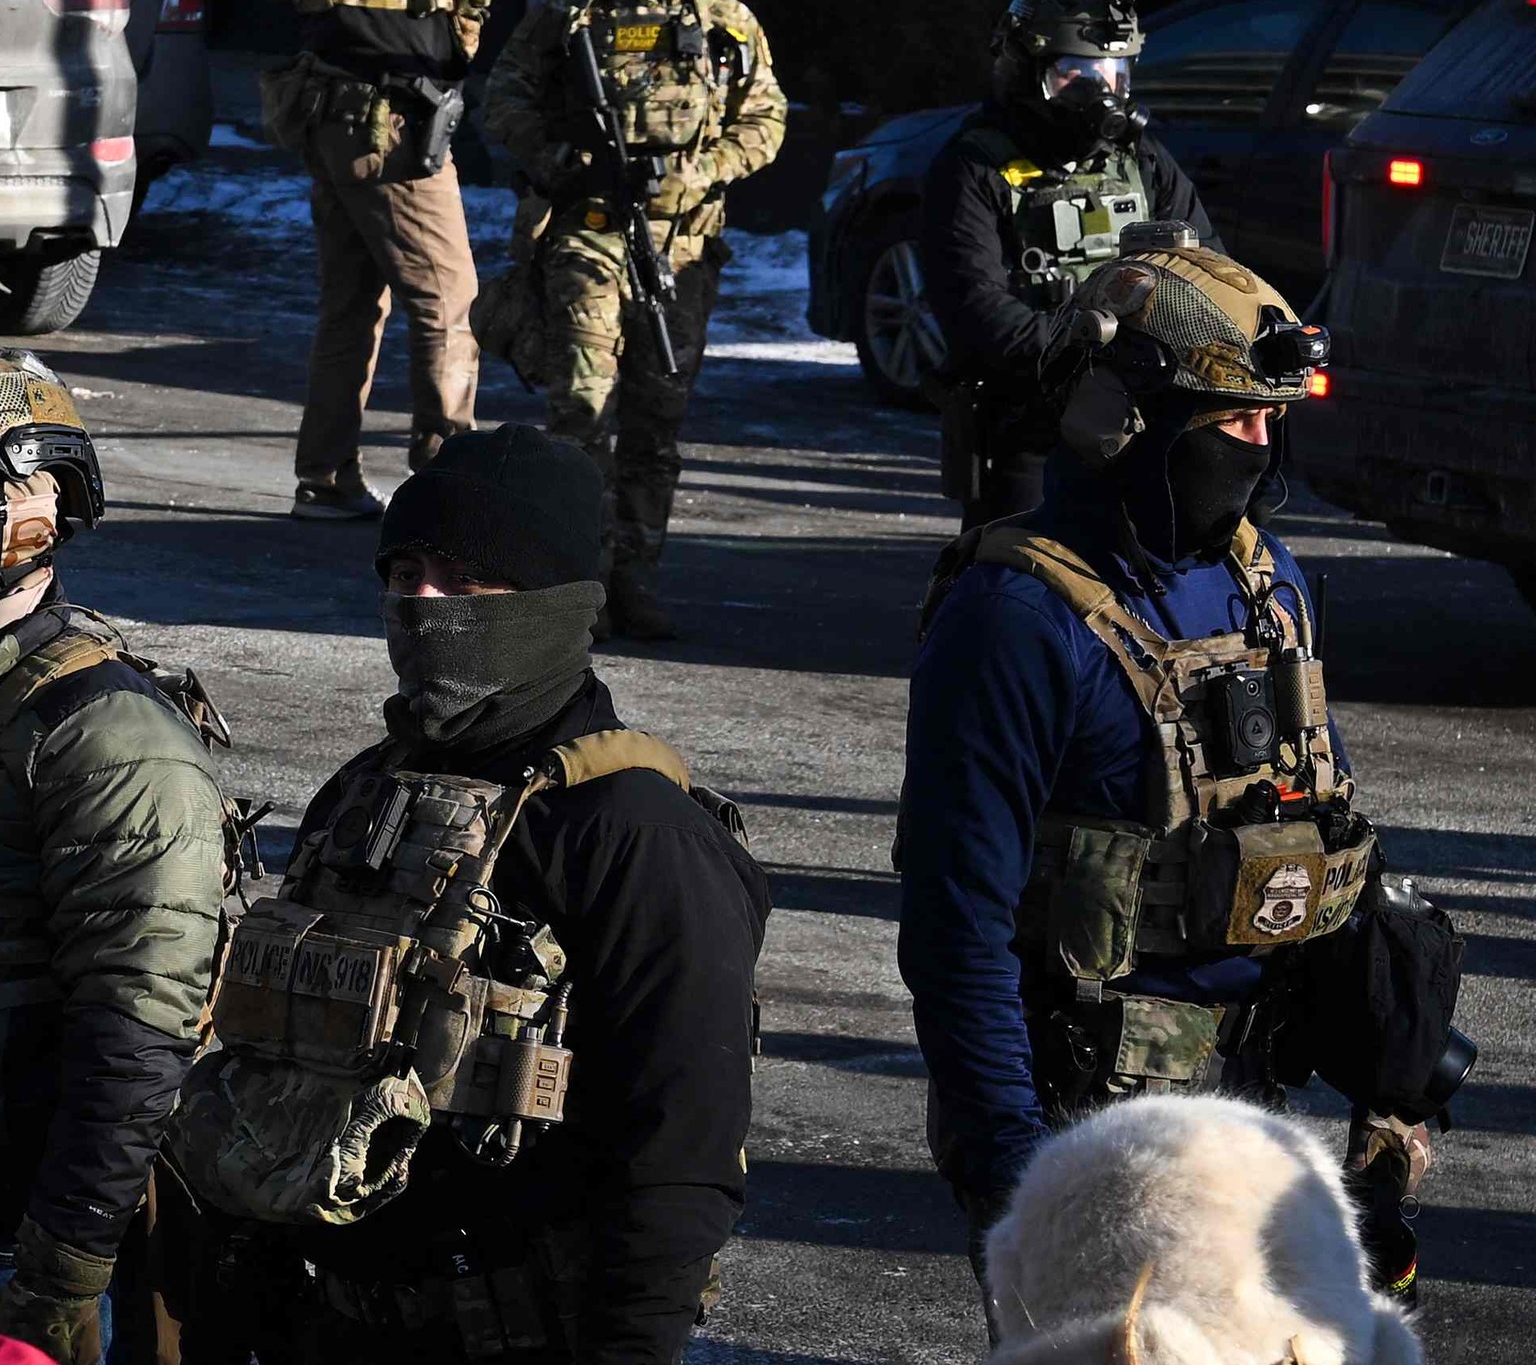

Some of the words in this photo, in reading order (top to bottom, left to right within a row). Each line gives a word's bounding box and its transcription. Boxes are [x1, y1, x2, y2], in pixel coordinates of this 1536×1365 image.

[616, 26, 661, 40] POLIC
[1464, 221, 1530, 259] SHERIFF
[231, 939, 290, 980] POLICE
